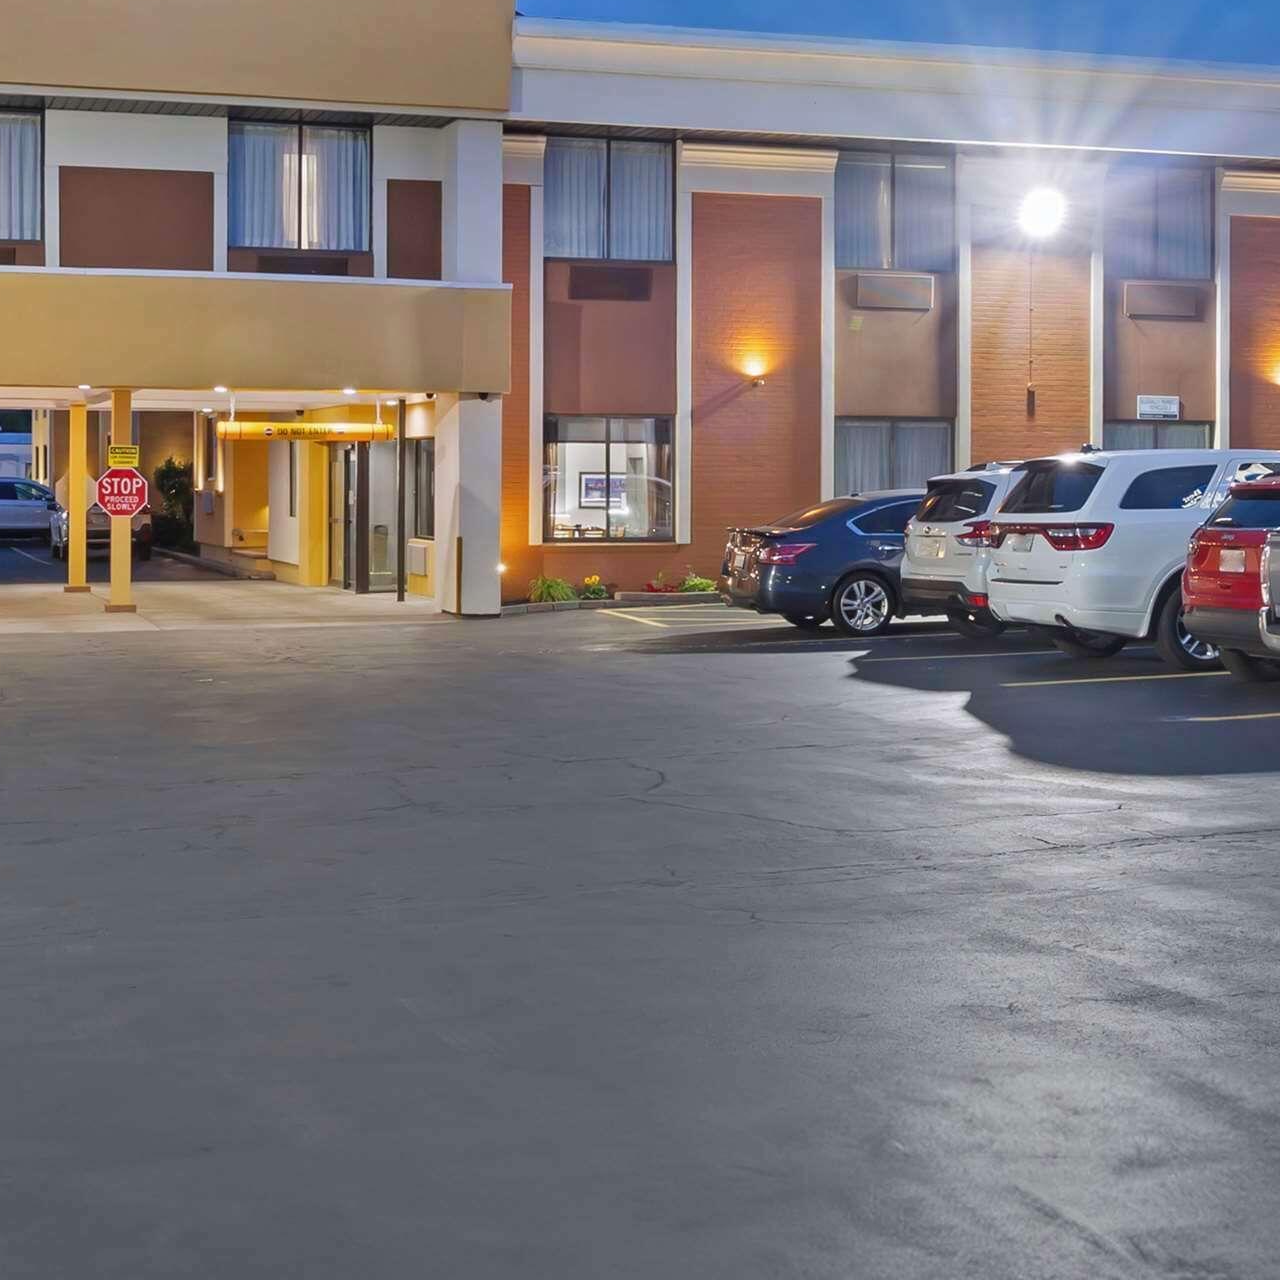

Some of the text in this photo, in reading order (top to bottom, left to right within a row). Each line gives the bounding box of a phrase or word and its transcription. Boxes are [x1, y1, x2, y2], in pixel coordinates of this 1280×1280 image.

[102, 478, 142, 495] STOP
[104, 495, 139, 503] PROCEED
[107, 503, 137, 511] SLOWLY
